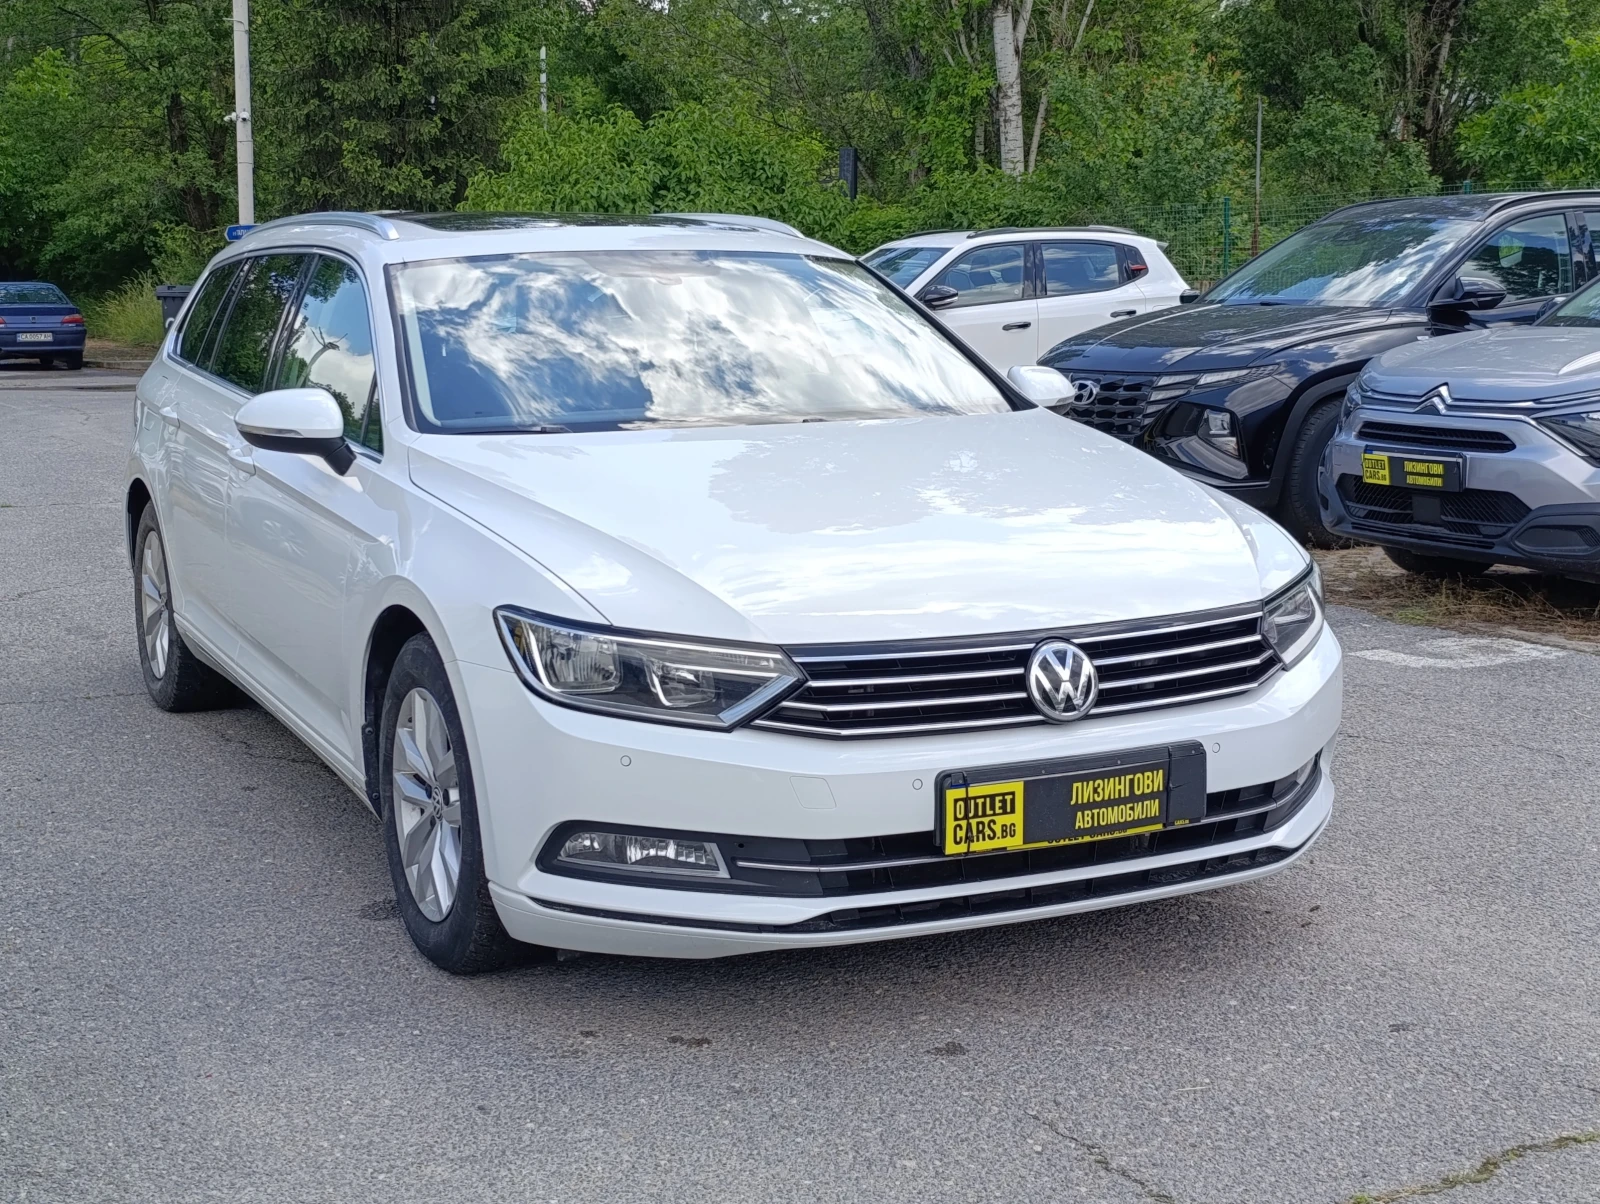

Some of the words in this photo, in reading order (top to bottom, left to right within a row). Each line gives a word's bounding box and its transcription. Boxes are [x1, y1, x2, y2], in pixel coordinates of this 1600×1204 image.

[1364, 459, 1385, 469] OUTLET
[1403, 461, 1444, 475] ЛИЗИНГОВИ
[1070, 769, 1164, 805] ЛИЗИНГОВИ
[955, 794, 1013, 819] OUTLET
[1074, 799, 1160, 830] АВТОМОБИЛИ
[953, 818, 1016, 846] CARS.BG
